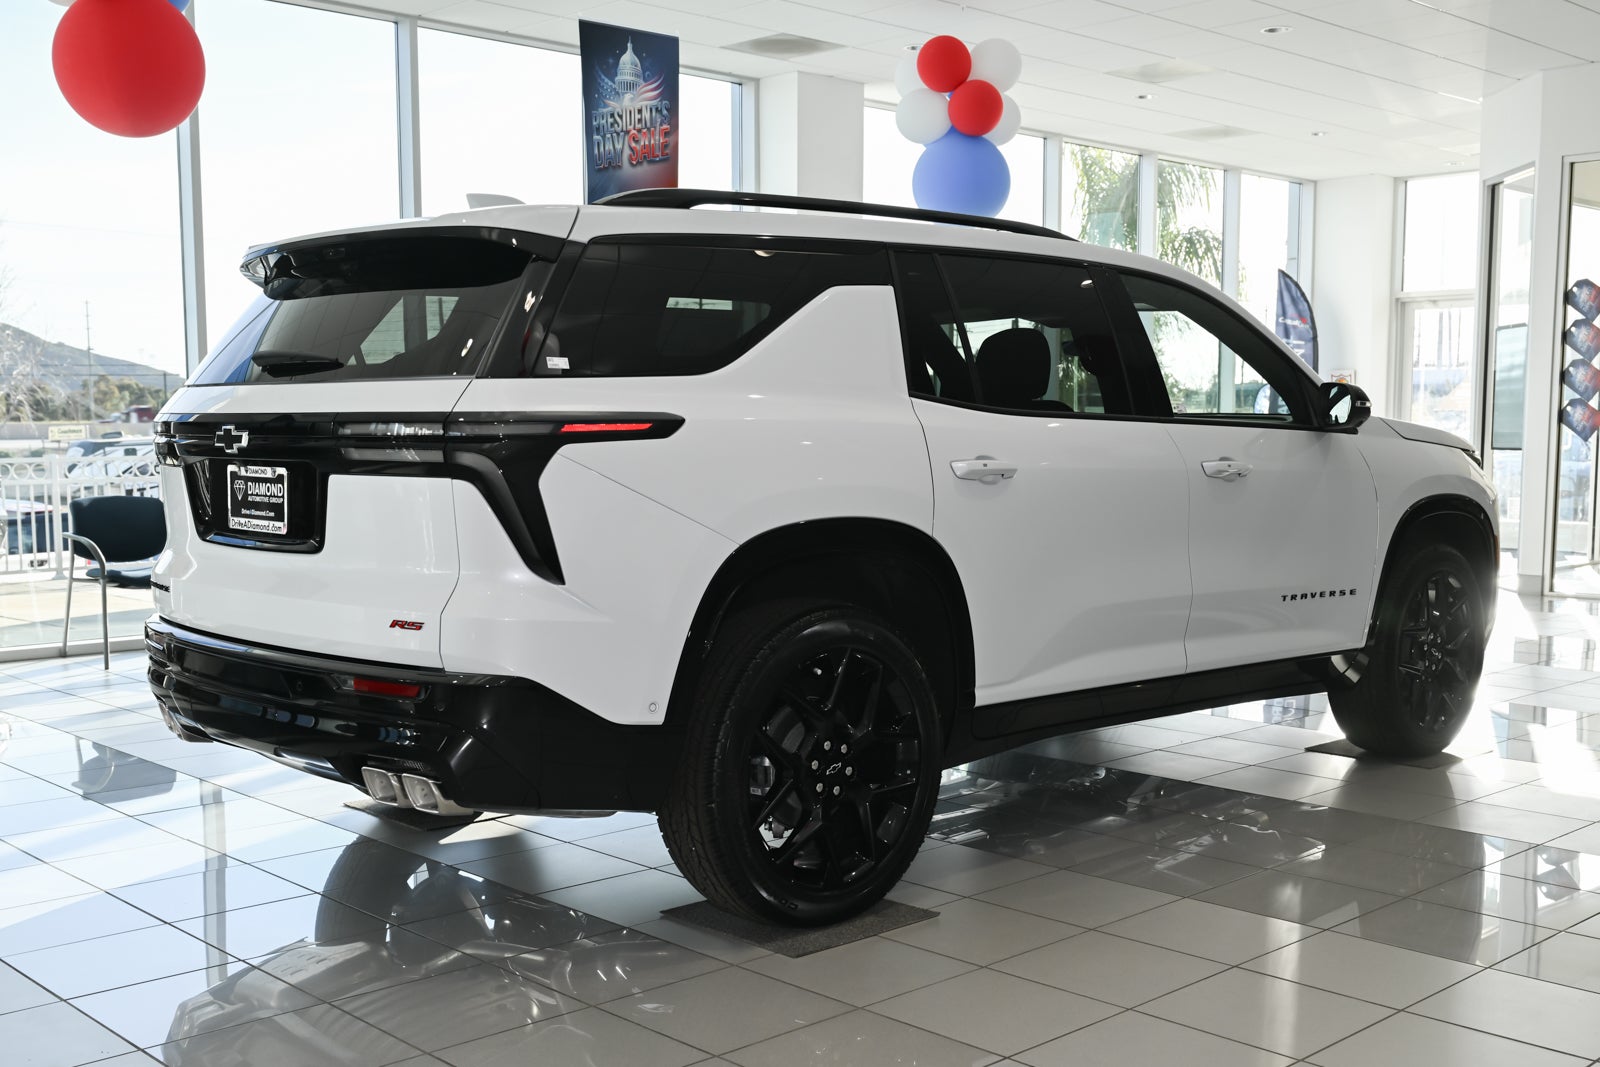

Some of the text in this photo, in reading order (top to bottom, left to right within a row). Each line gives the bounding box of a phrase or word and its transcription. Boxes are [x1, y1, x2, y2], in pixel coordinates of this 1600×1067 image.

[591, 101, 671, 135] PRESIDENT'S
[592, 124, 670, 169] DAY SALE
[248, 467, 268, 475] DIAMOND
[248, 482, 283, 496] DIAMOND
[1281, 589, 1357, 602] TRAVERSE
[389, 620, 424, 630] RS
